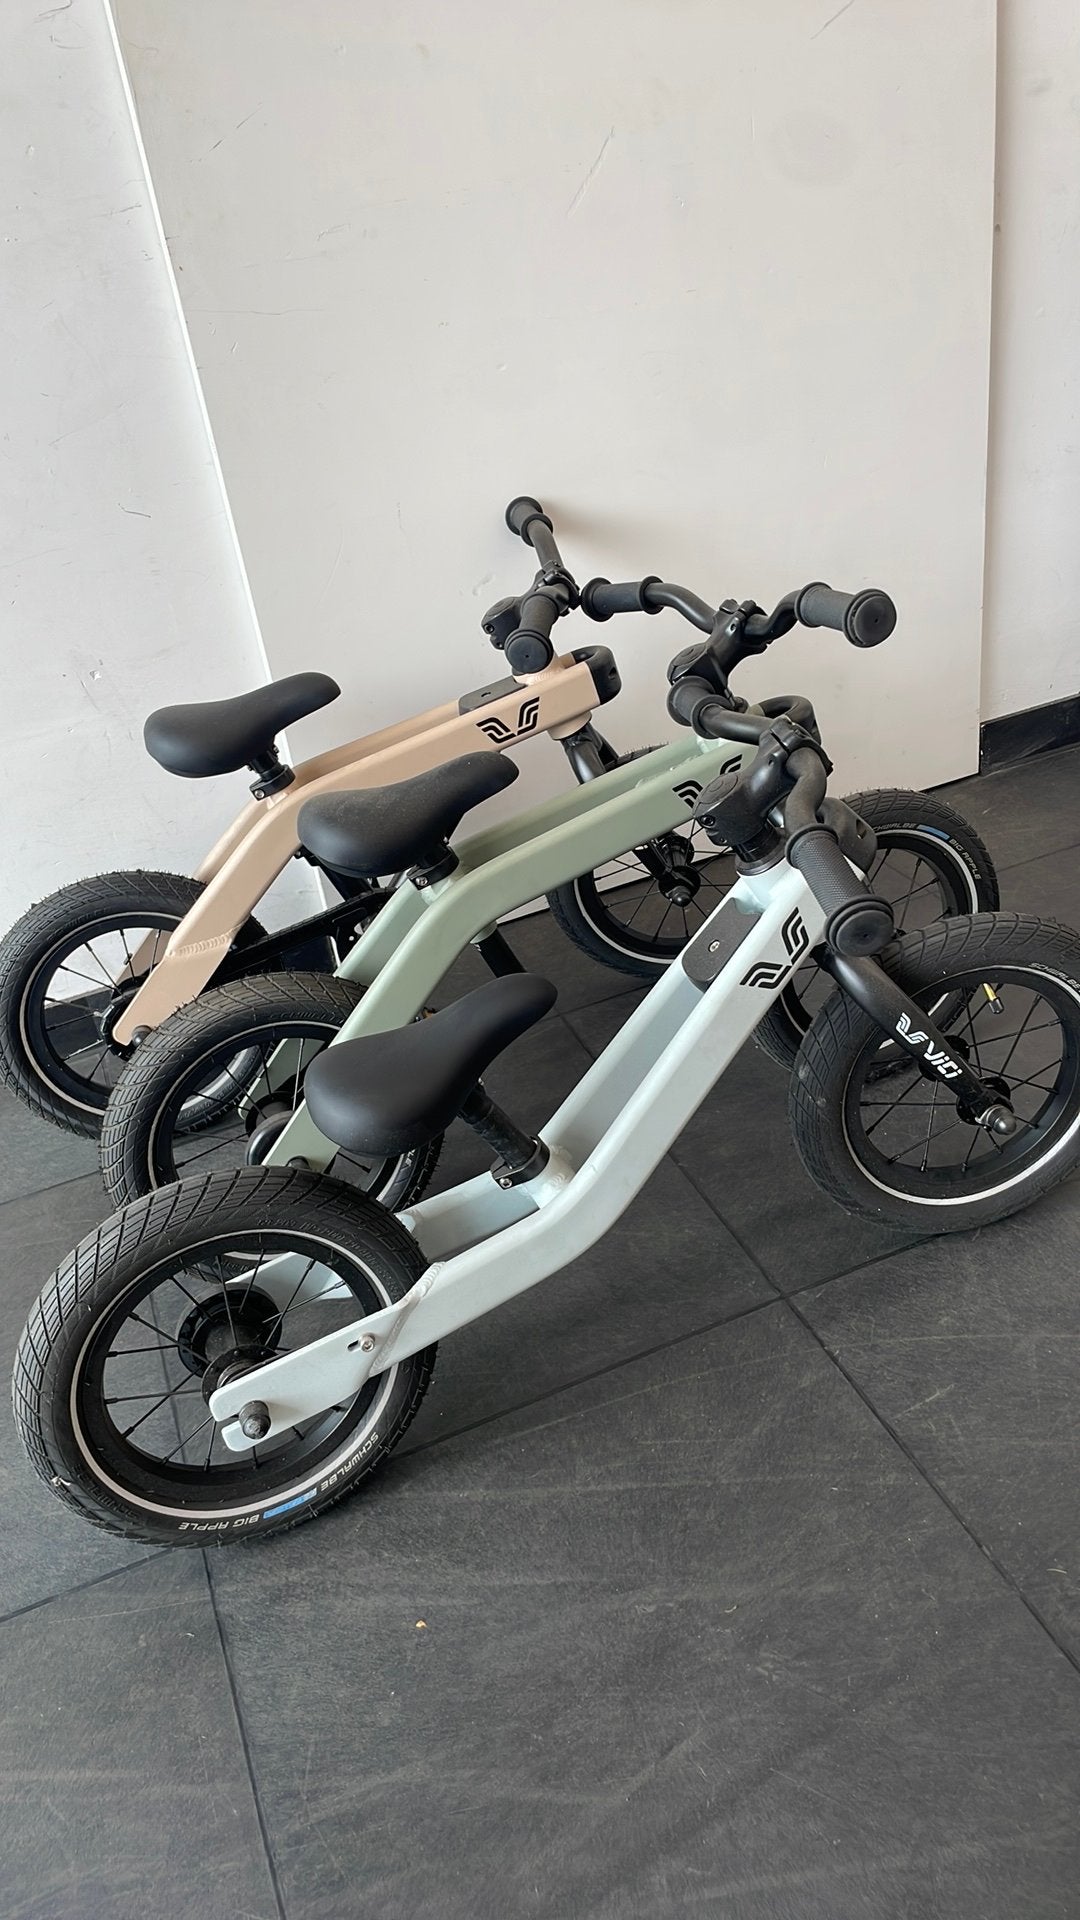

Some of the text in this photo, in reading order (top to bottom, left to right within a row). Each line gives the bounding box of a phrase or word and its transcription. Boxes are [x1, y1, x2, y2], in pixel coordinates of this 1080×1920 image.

[873, 822, 982, 880] CHWALBE BIG APPLE
[178, 1431, 379, 1531] SCHWALBE BIG APPLE
